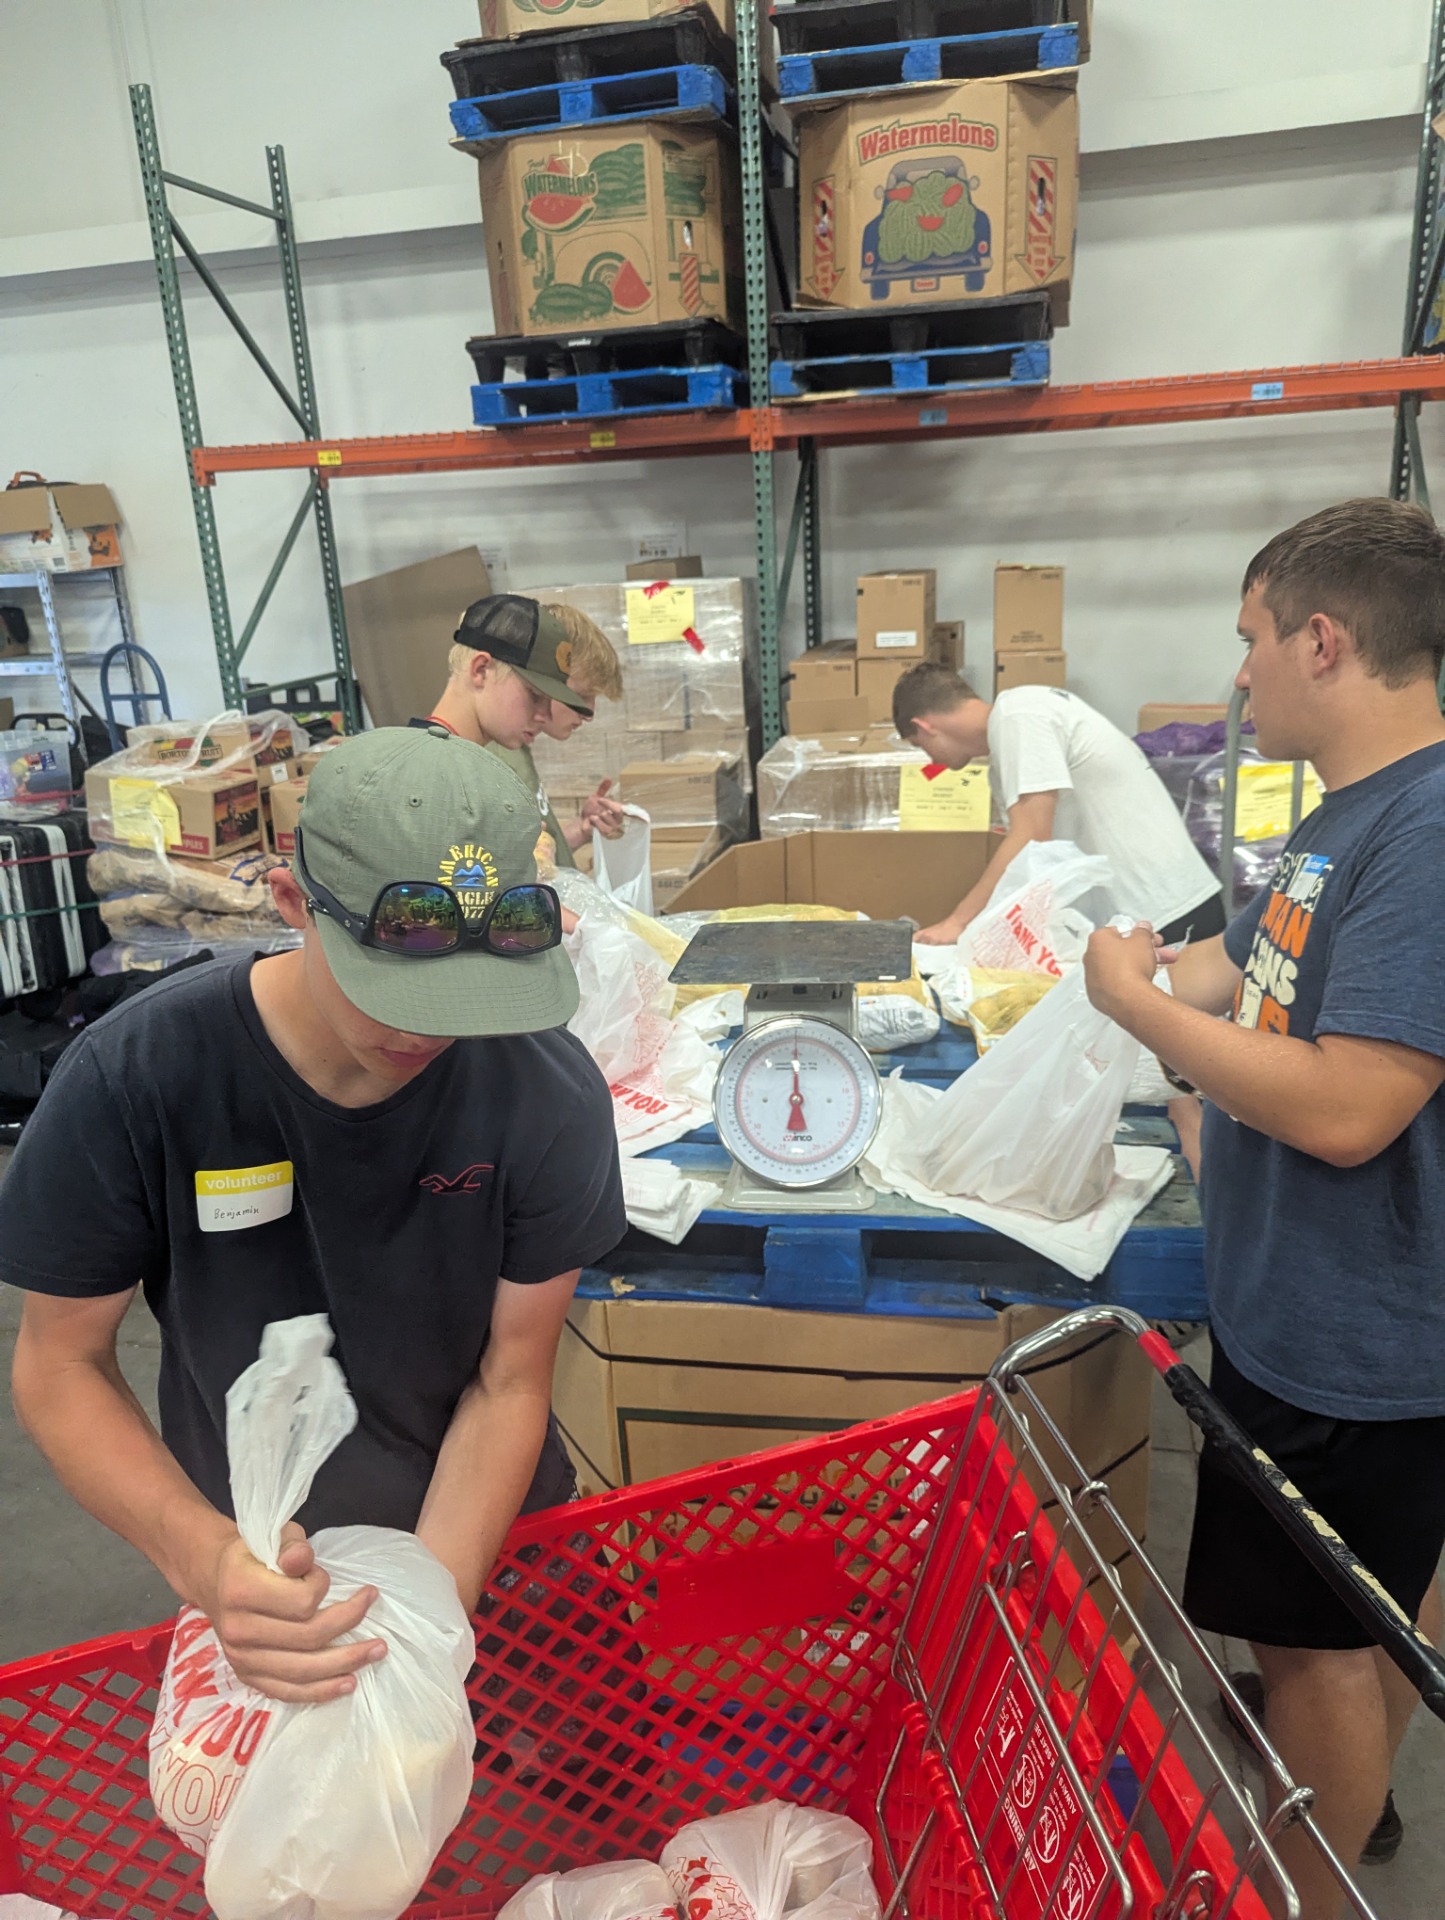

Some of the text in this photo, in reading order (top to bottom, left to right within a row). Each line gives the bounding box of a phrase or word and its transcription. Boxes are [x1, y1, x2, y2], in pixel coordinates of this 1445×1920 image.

[860, 117, 996, 161] Watermelons
[524, 171, 596, 200] WATERMELONS
[437, 844, 499, 888] AMERICAN
[456, 890, 495, 905] AGLE
[461, 905, 486, 919] 977
[624, 1091, 669, 1115] YOU
[205, 1171, 282, 1190] volunteer
[214, 1205, 260, 1220] Benjamin
[1057, 1774, 1076, 1816] ALWAYS
[1003, 1795, 1031, 1863] WRNING
